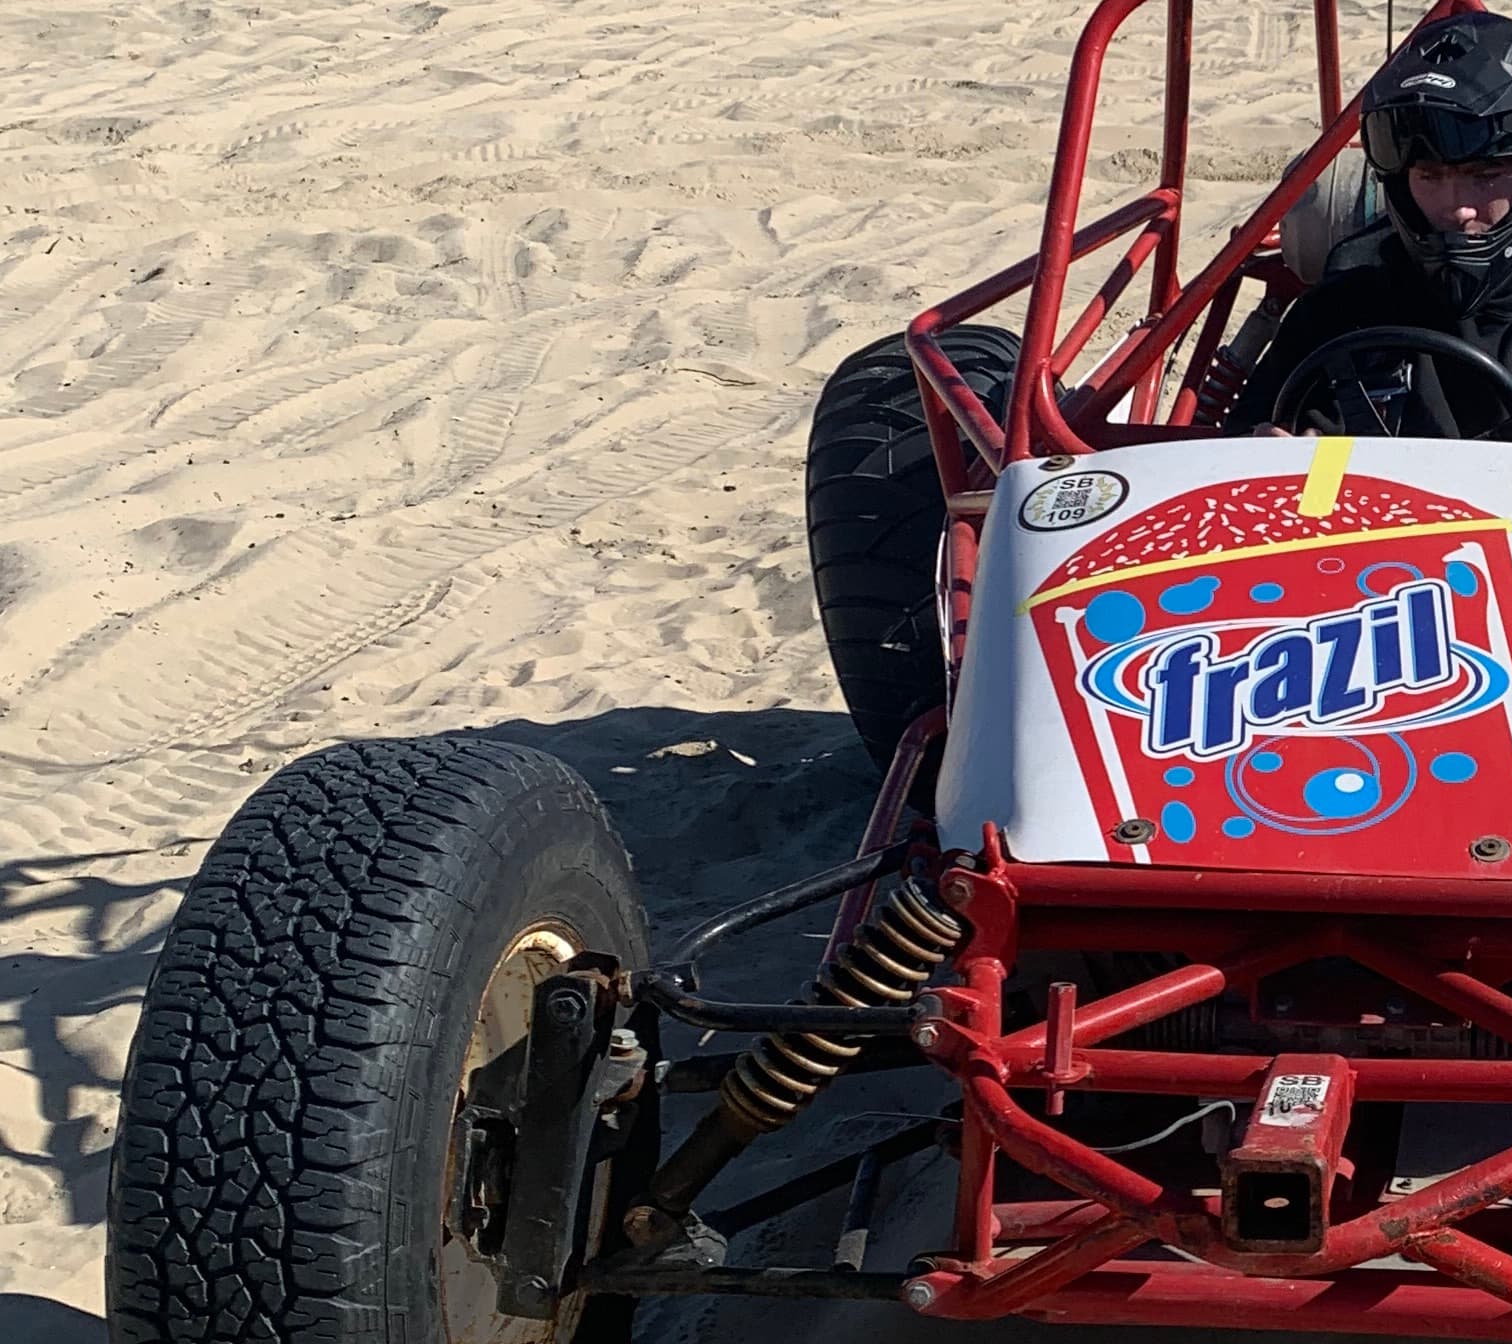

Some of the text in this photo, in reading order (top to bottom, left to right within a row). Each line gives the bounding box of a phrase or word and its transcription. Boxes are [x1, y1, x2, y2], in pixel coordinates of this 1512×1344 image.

[1060, 477, 1095, 490] SB
[1045, 508, 1086, 523] 109
[1142, 580, 1455, 758] frazil
[1279, 1076, 1323, 1086] SB
